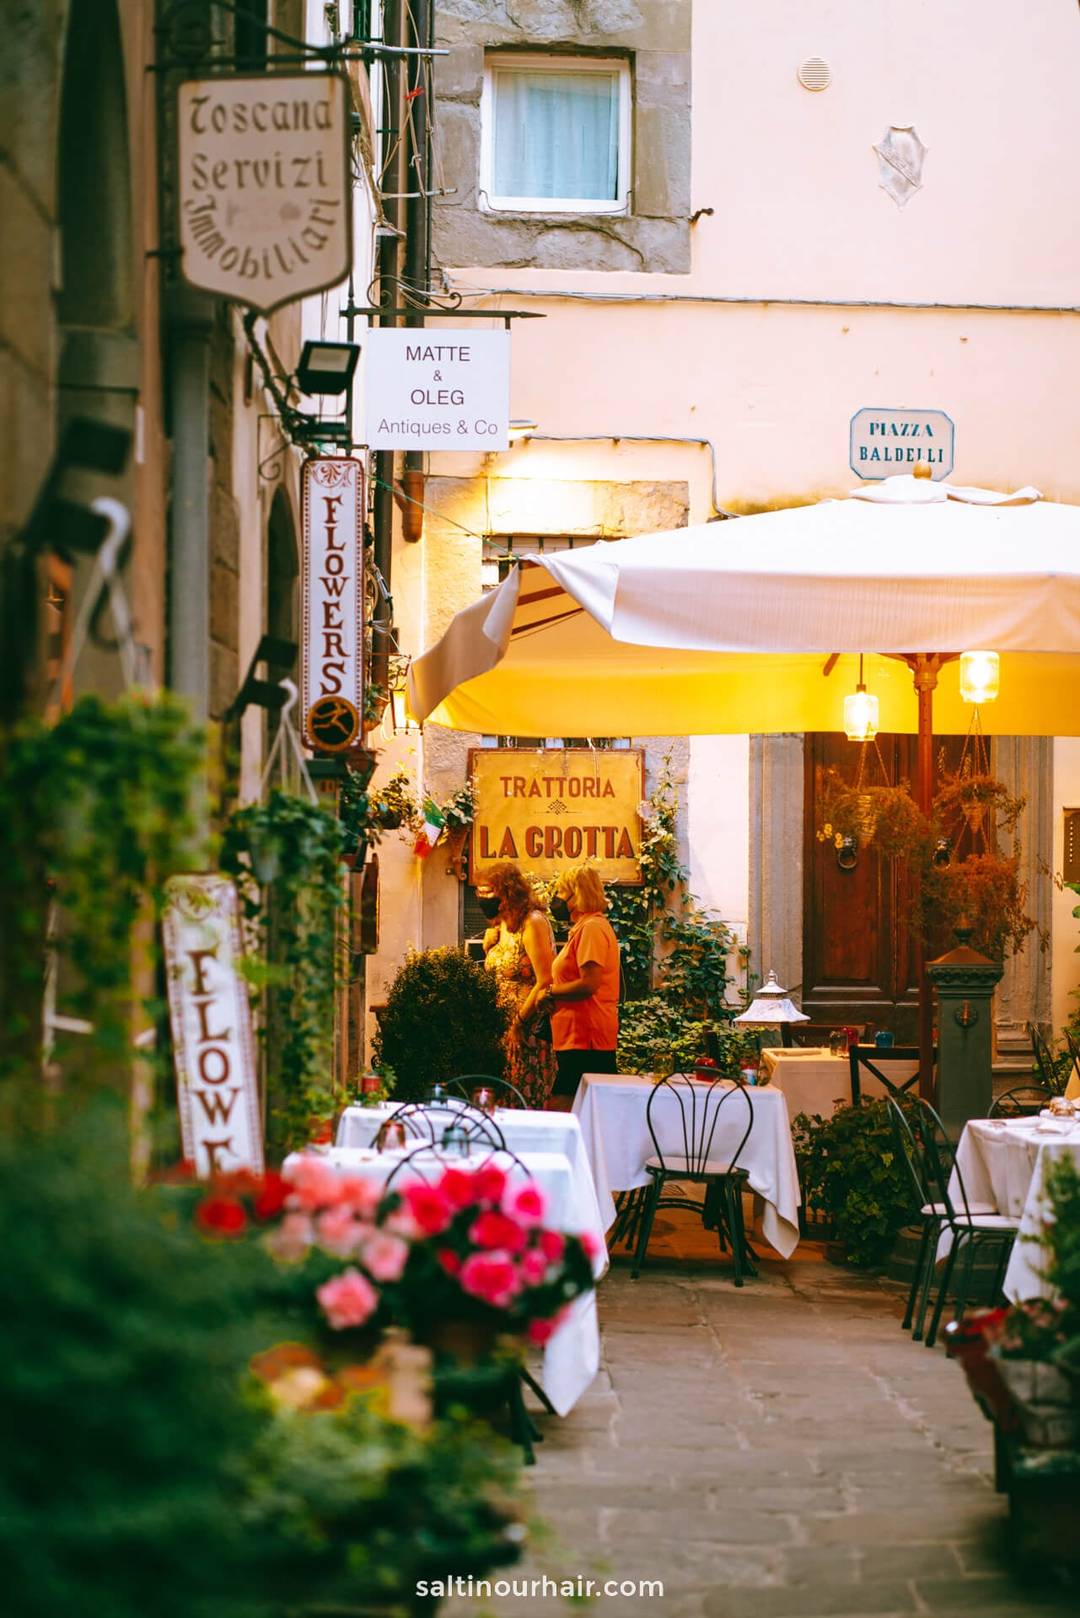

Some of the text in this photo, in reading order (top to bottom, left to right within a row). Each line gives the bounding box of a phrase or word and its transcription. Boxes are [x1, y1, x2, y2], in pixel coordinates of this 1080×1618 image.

[188, 94, 333, 134] Toscana
[190, 150, 329, 191] Servizi
[183, 193, 341, 280] Immobiliari
[405, 345, 471, 362] MATTE
[433, 369, 443, 381] &
[410, 388, 465, 406] OLEG
[377, 418, 498, 437] Antiques & Co
[869, 422, 934, 437] PIAZZA
[859, 446, 944, 463] BALDELLI
[318, 494, 351, 696] FLOWERS
[499, 776, 616, 798] TRATTORIA
[479, 825, 636, 859] LA GROTTA
